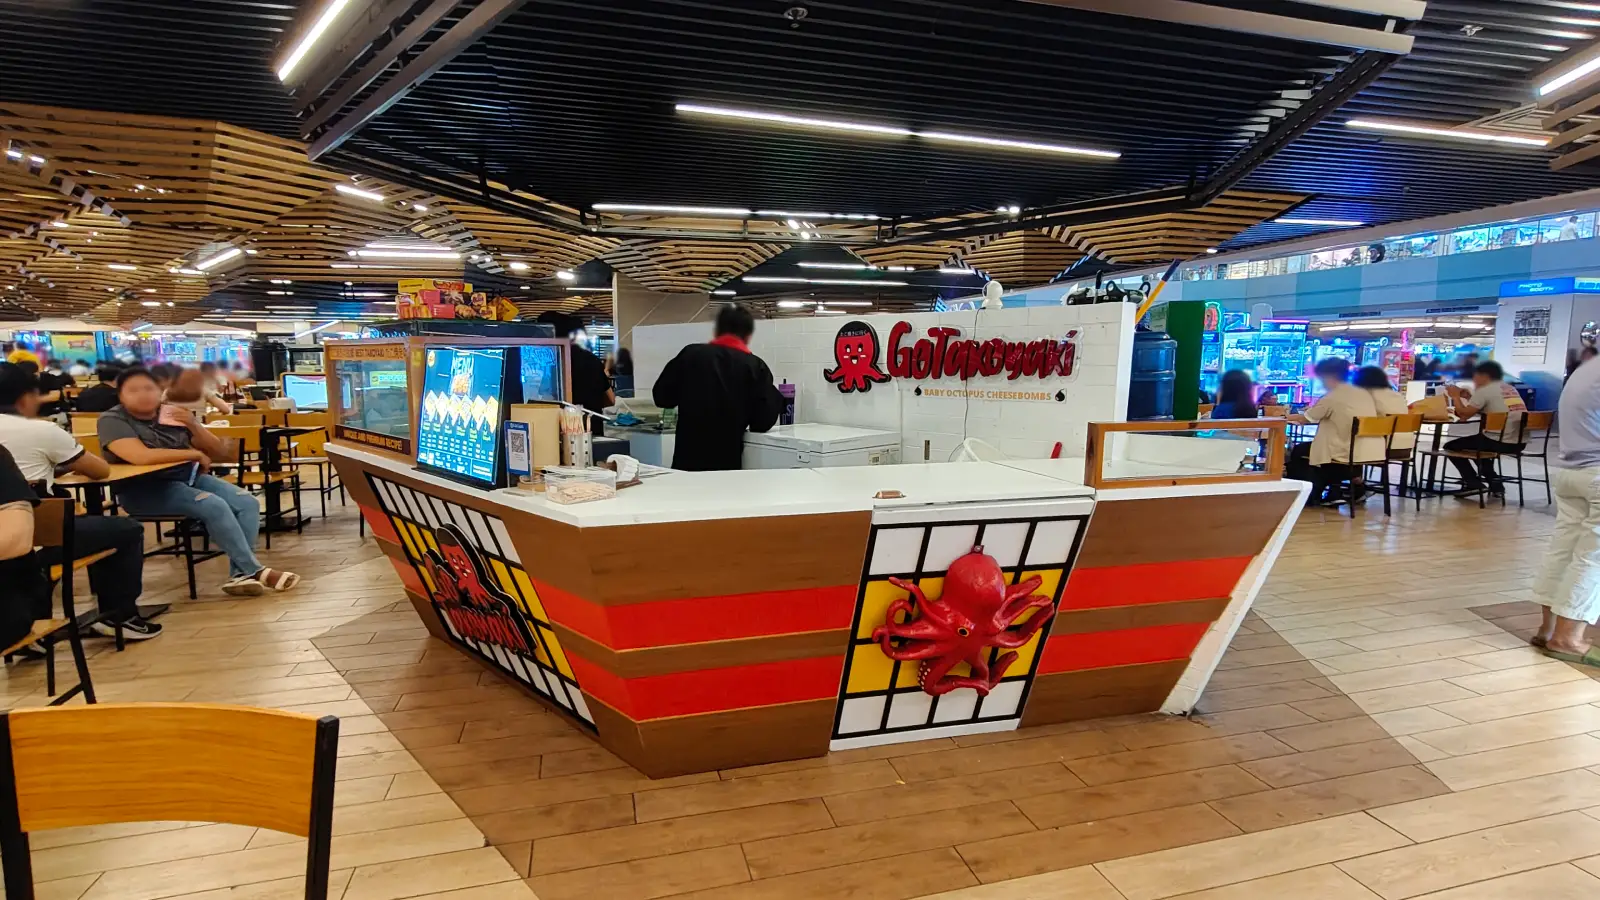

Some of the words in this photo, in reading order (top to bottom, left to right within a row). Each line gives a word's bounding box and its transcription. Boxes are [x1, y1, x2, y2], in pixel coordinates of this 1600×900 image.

[886, 321, 1077, 381] GoTakoyaki
[452, 356, 474, 376] MENU
[924, 388, 944, 397] BABY
[946, 389, 985, 398] OCTOPUS
[987, 391, 1051, 401] CHEESEBOMBS
